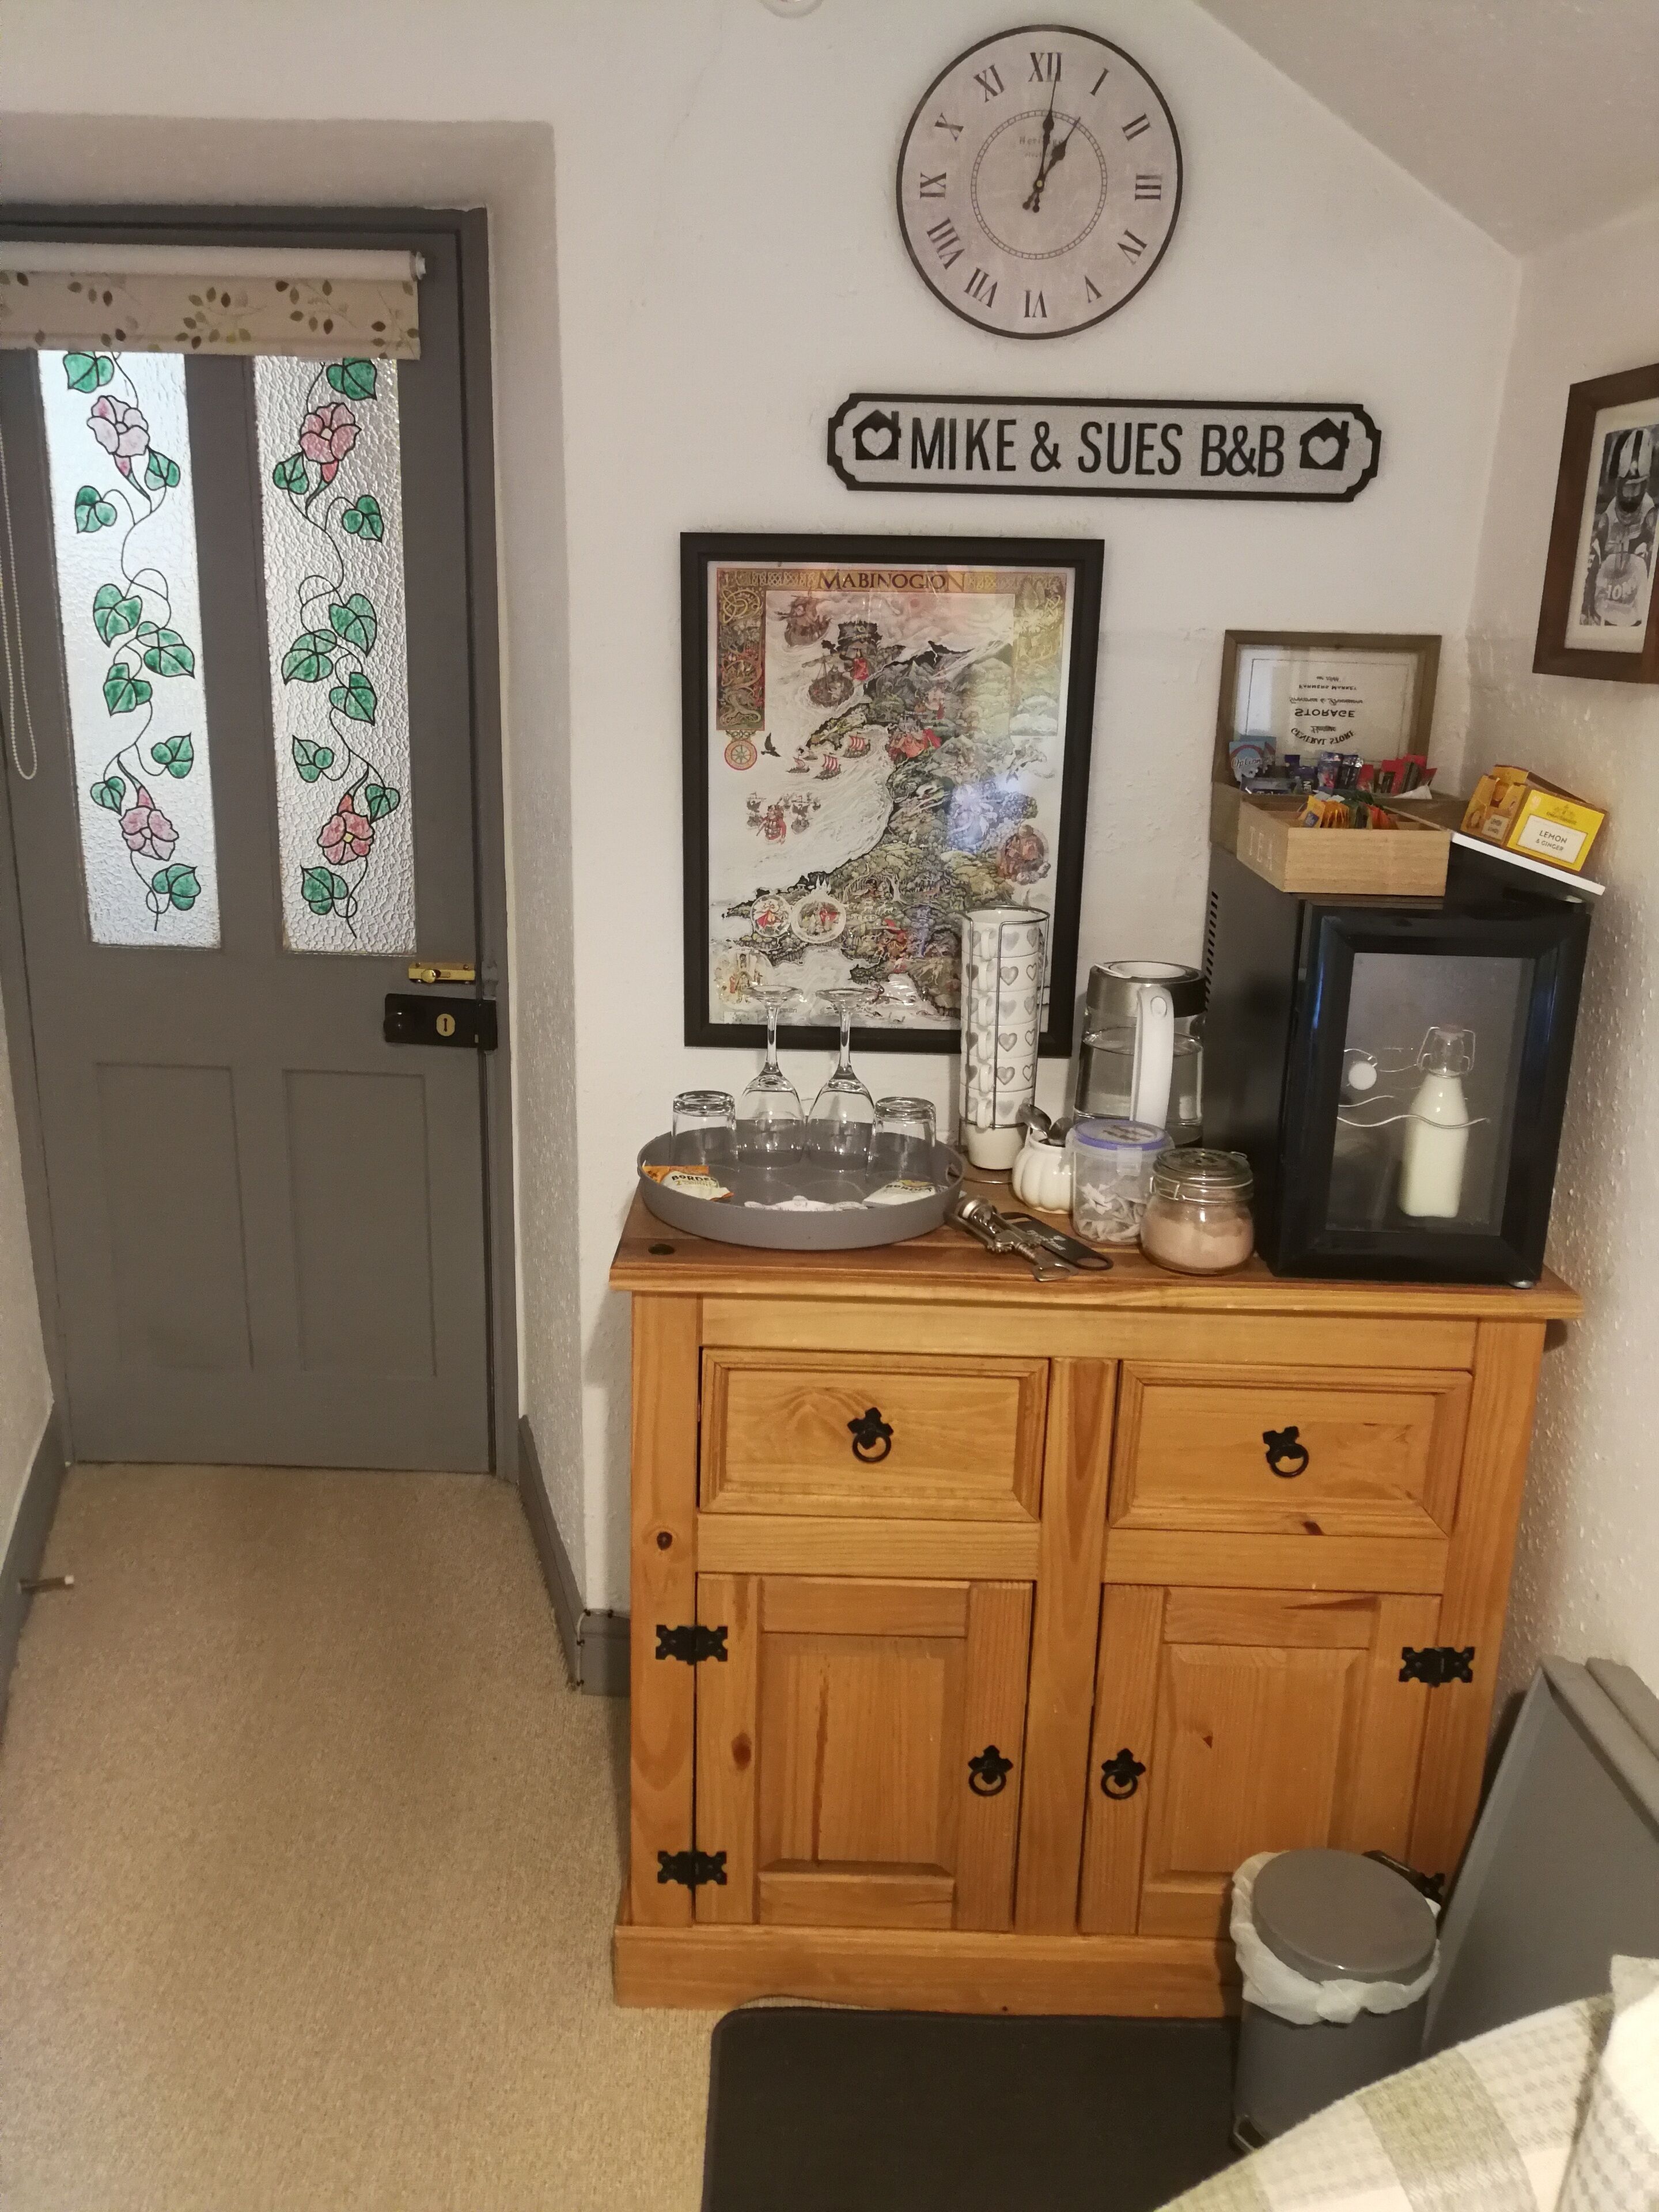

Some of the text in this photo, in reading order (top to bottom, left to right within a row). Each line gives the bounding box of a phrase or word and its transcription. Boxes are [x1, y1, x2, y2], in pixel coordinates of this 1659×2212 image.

[1028, 52, 1062, 82] XII
[974, 65, 1005, 103] XI
[1090, 68, 1109, 96] I
[934, 112, 964, 141] X
[1122, 113, 1152, 141] II
[920, 172, 946, 199] IX
[1135, 173, 1162, 200] III
[926, 217, 965, 270] VIII
[1117, 229, 1147, 265] IV
[964, 267, 998, 308] VII
[1084, 275, 1103, 303] V
[1024, 290, 1047, 318] VI
[910, 417, 1285, 478] MIKE & SUES B&B
[817, 570, 966, 593] MABINOGION
[1539, 830, 1567, 844] LEMON
[1541, 840, 1565, 852] GINGER
